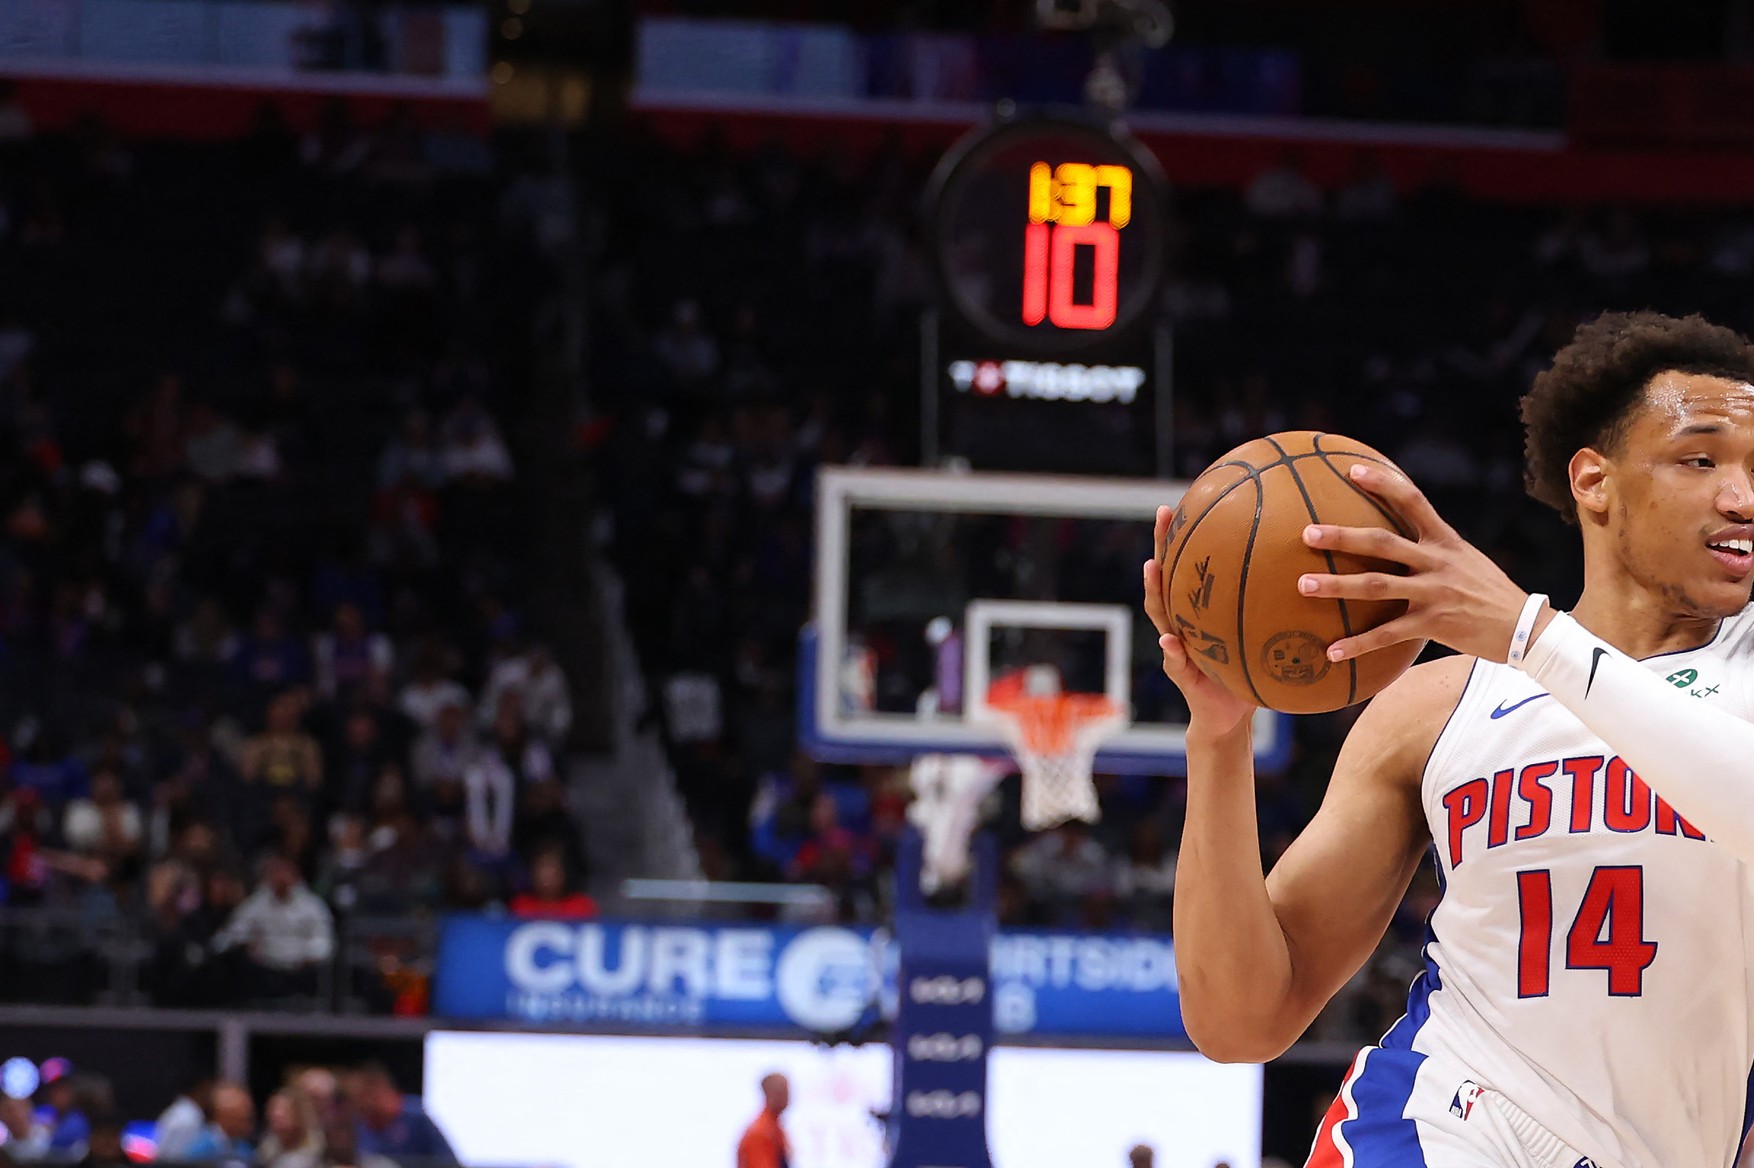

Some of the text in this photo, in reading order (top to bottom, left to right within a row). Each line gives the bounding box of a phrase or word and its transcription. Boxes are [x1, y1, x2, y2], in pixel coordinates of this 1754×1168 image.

[1022, 221, 1120, 331] 10
[504, 920, 775, 1001] CURE
[1516, 864, 1658, 999] 14
